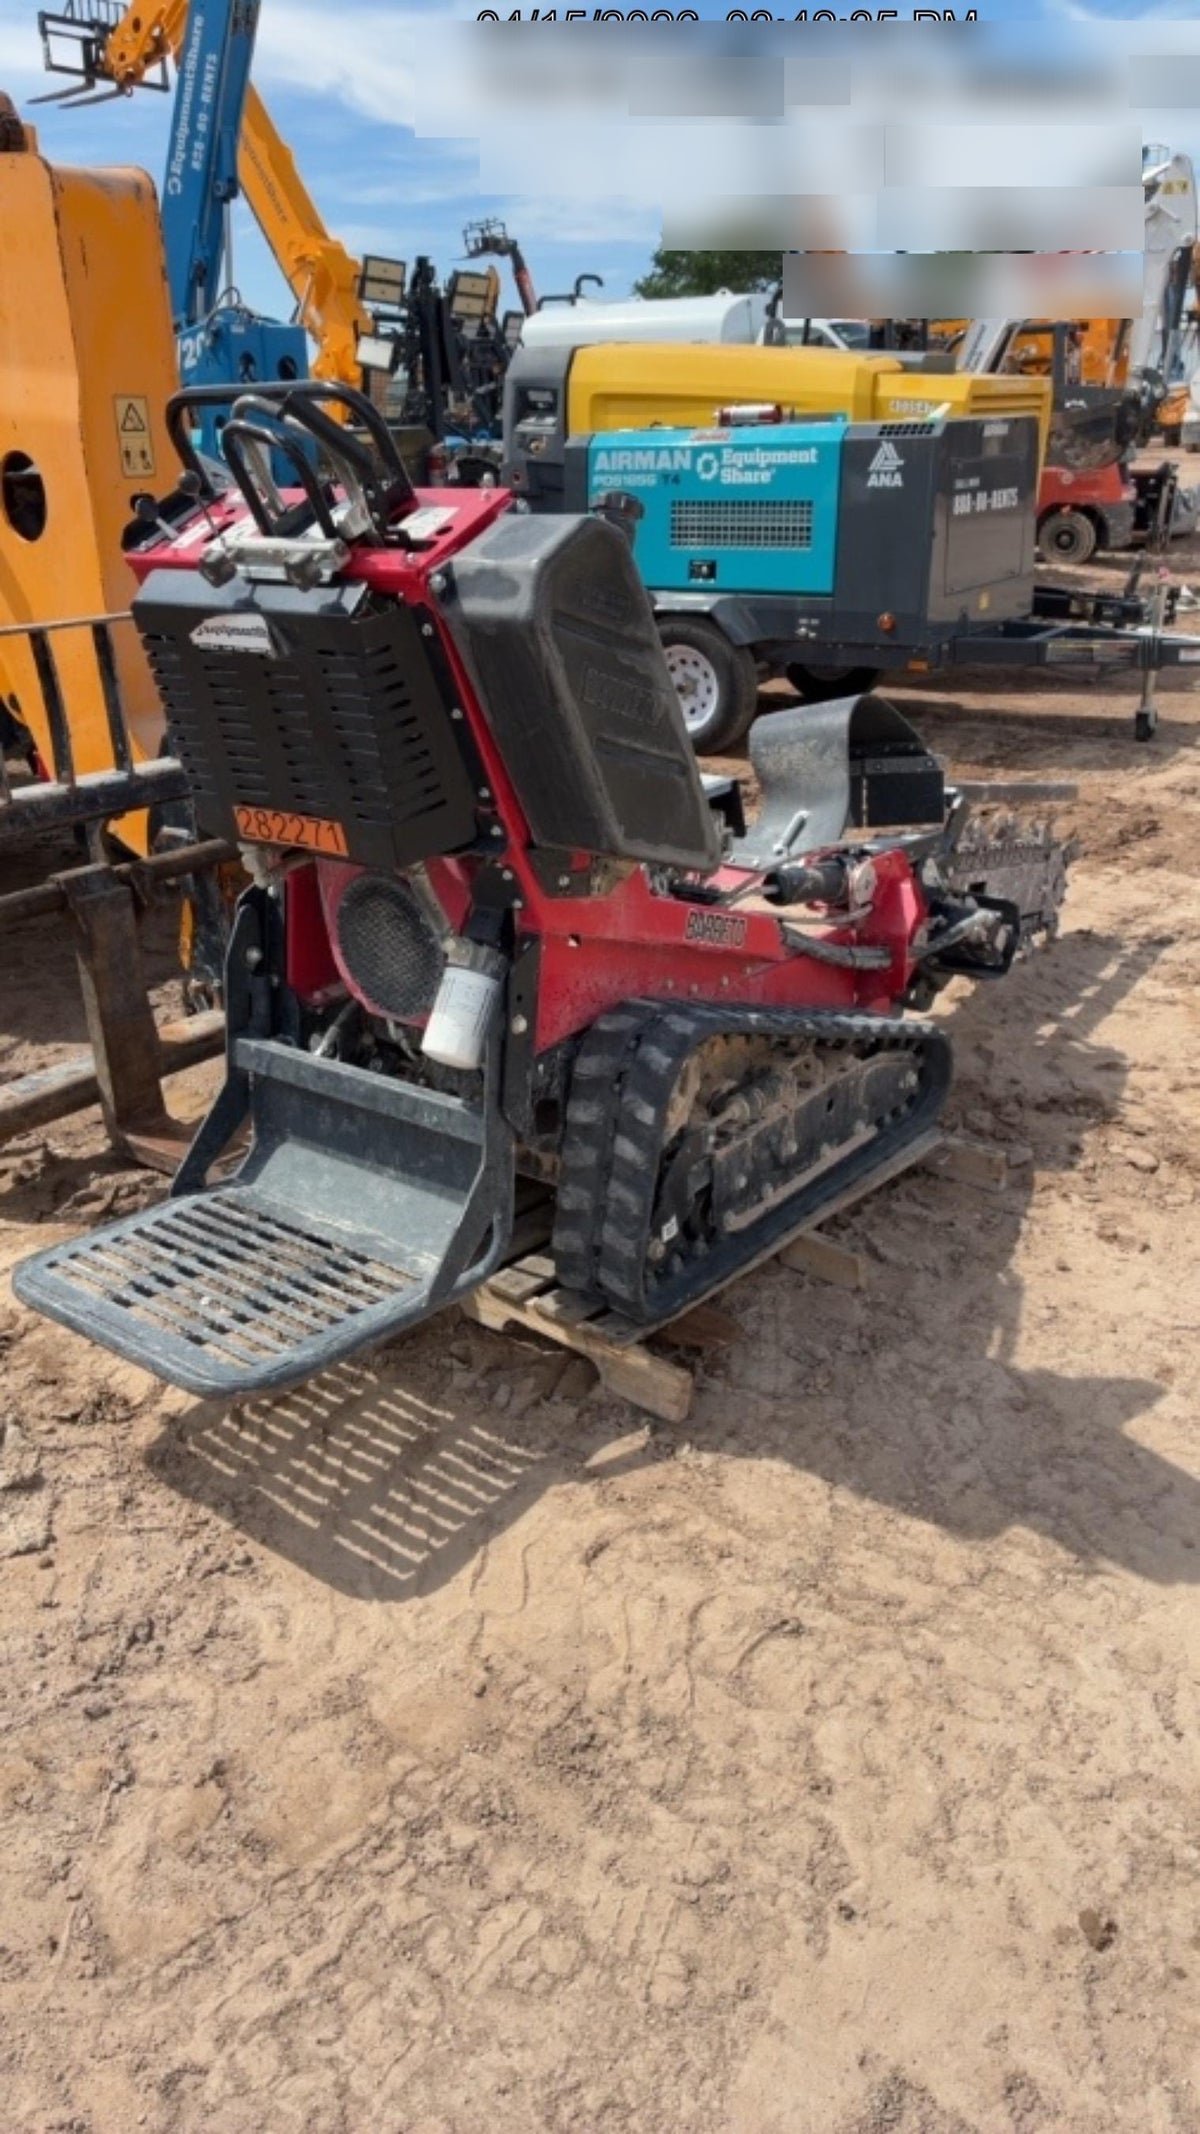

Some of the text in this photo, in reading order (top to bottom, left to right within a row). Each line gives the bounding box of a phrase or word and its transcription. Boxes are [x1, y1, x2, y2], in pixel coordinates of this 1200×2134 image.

[594, 450, 692, 471] AIRMAN
[721, 448, 818, 468] Equipment
[662, 473, 681, 486] T4
[721, 466, 772, 485] Share
[867, 472, 904, 488] ANA
[236, 808, 341, 852] 282271
[685, 909, 748, 949] BARRETO
